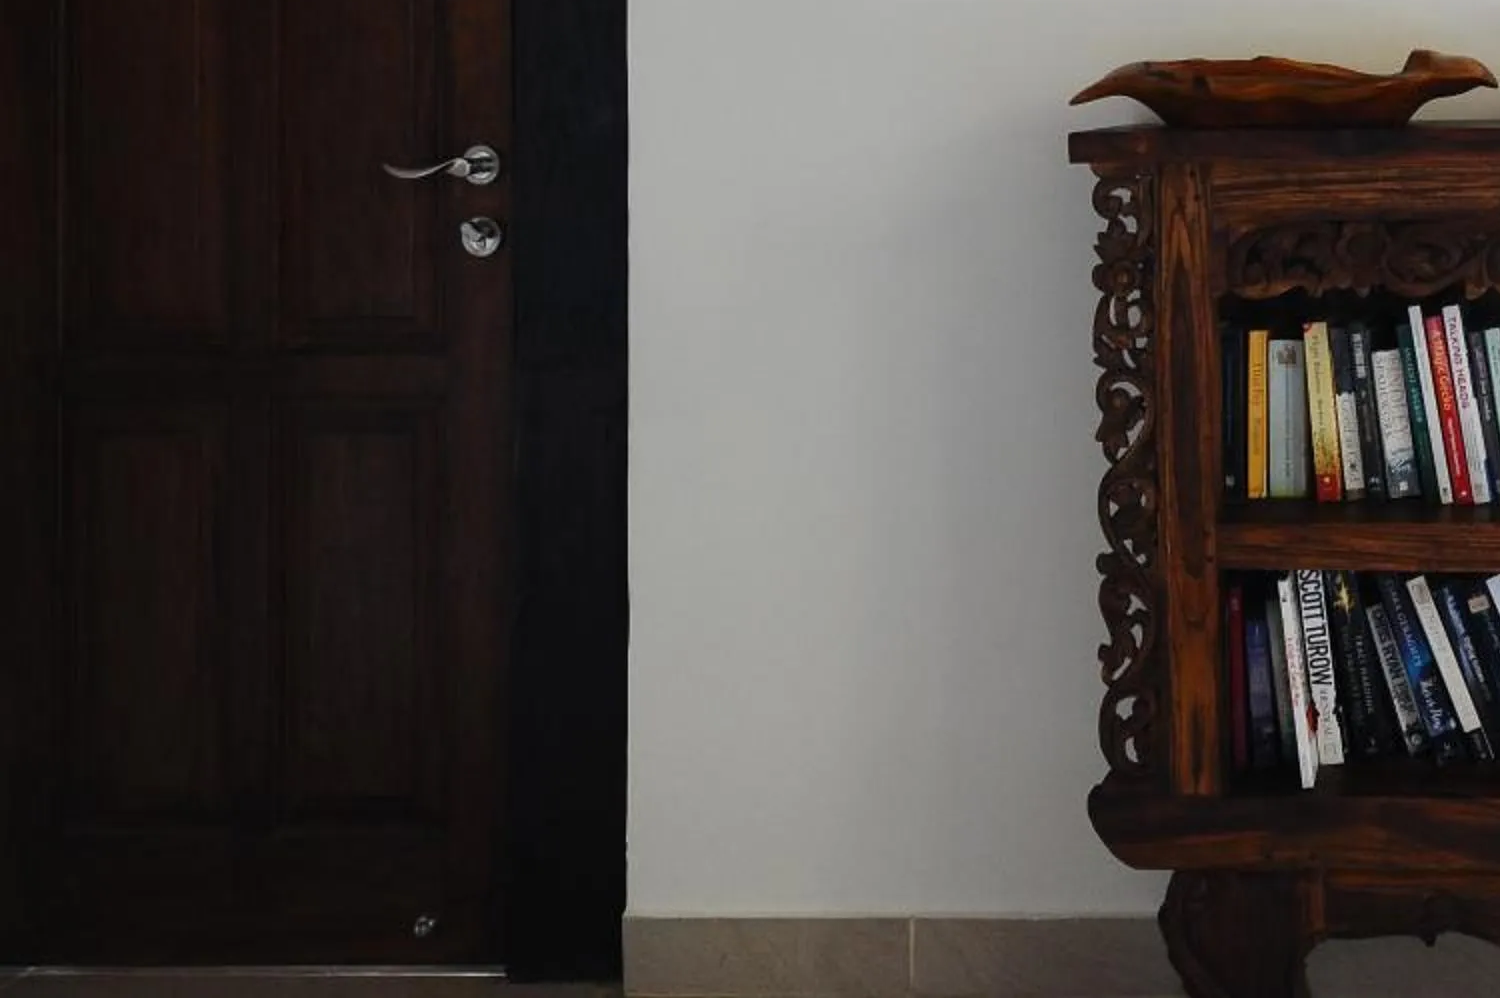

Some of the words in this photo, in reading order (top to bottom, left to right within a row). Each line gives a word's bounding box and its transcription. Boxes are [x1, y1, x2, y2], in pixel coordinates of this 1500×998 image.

[1447, 316, 1462, 367] TALKING
[1455, 370, 1469, 409] HEADS
[1300, 570, 1324, 620] SCOTT
[1305, 624, 1332, 686] TUROW
